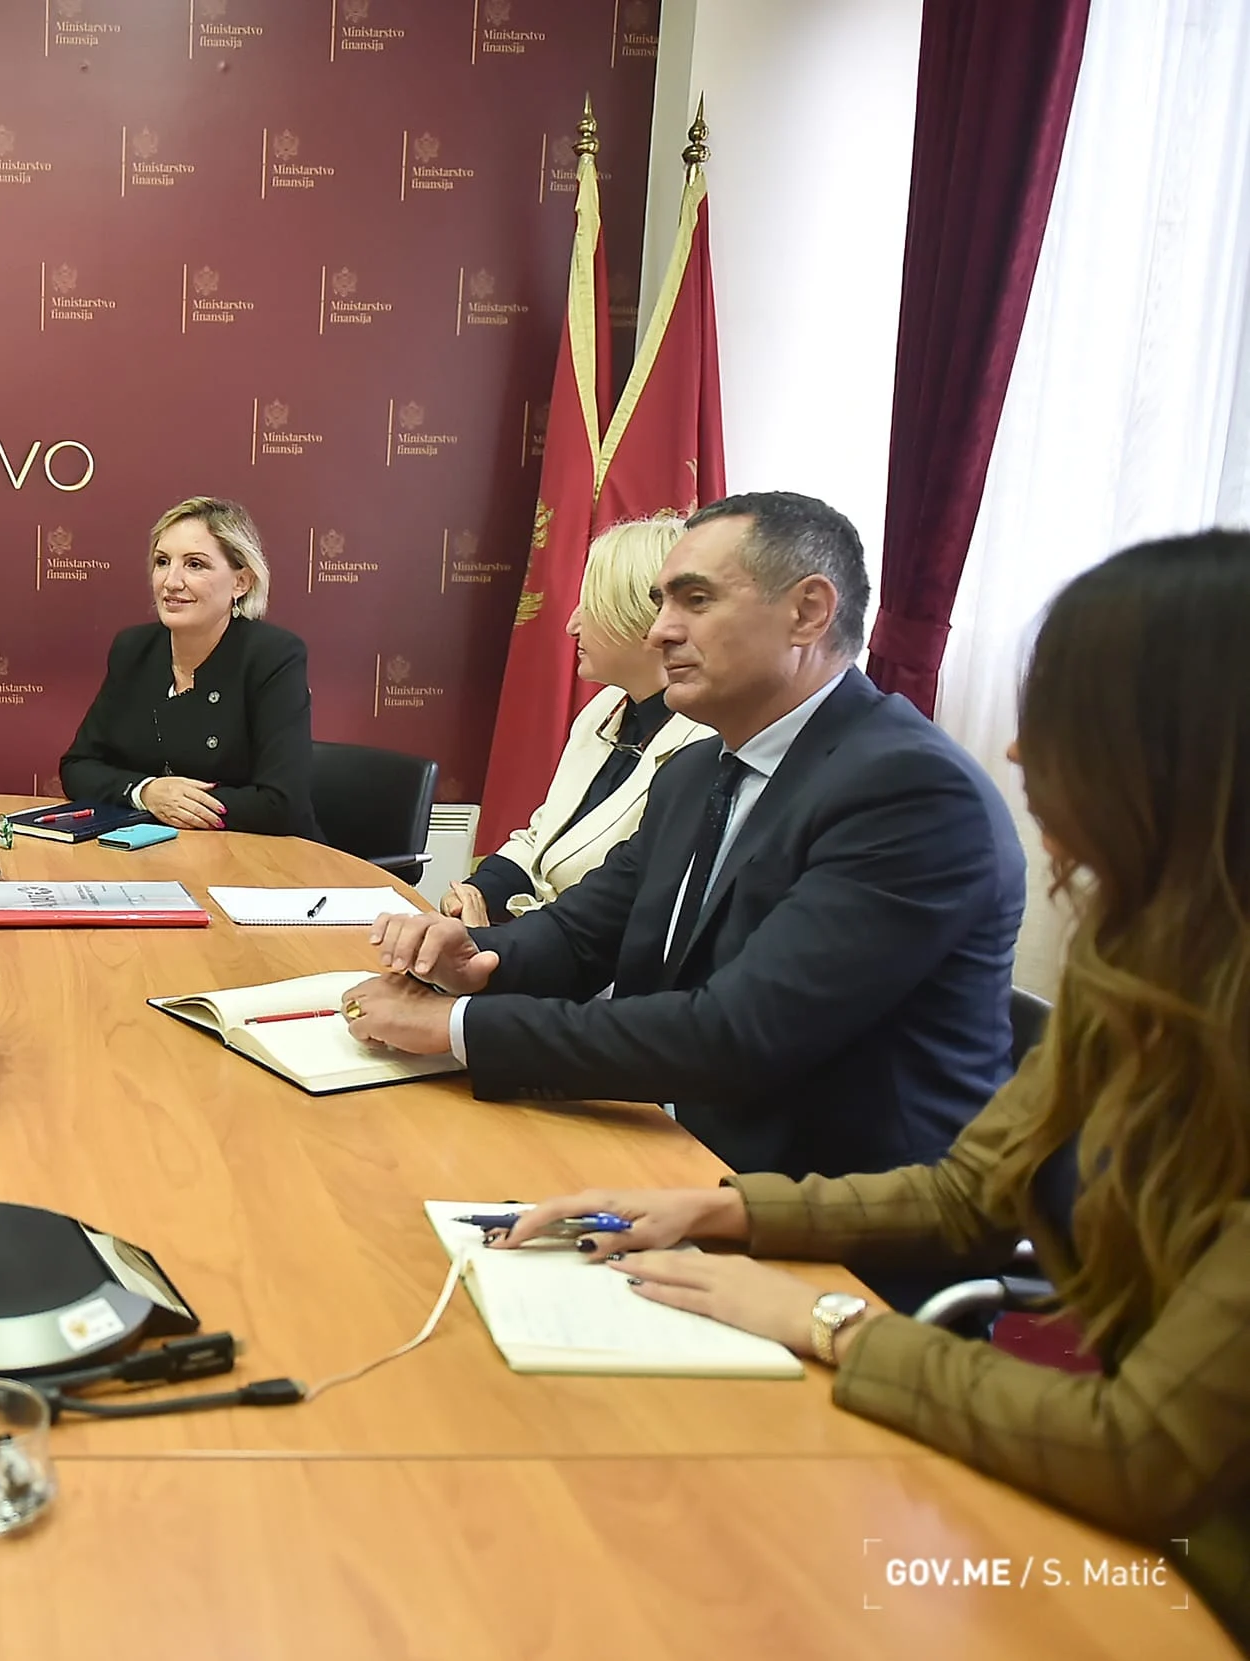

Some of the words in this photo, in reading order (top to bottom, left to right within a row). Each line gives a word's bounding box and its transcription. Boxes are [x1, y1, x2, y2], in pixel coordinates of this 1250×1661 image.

[56, 21, 121, 33] Ministarstvo
[200, 24, 263, 36] Ministarstvo
[342, 27, 405, 39] Ministarstvo
[55, 33, 99, 45] finansija
[199, 36, 243, 48] finansija
[483, 30, 546, 42] Ministarstvo
[341, 39, 384, 51] finansija
[482, 42, 525, 54] finansija
[132, 162, 195, 174] Ministarstvo
[273, 164, 335, 176] Ministarstvo
[412, 166, 474, 178] Ministarstvo
[131, 174, 175, 186] finansija
[272, 176, 315, 188] finansija
[411, 178, 454, 190] finansija
[52, 296, 116, 308] Ministarstvo
[193, 299, 254, 311] Ministarstvo
[331, 300, 392, 312] Ministarstvo
[468, 302, 529, 314] Ministarstvo
[51, 308, 93, 320] finansija
[192, 311, 234, 323] finansija
[330, 312, 372, 324] finansija
[467, 314, 509, 326] finansija
[263, 432, 323, 444] Ministarstvo
[398, 433, 458, 445] Ministarstvo
[262, 444, 303, 455] finansija
[396, 445, 438, 456] finansija
[47, 559, 110, 571] Ministarstvo
[319, 560, 378, 572] Ministarstvo
[452, 561, 511, 573] Ministarstvo
[46, 571, 88, 582] finansija
[318, 572, 359, 583] finansija
[451, 573, 492, 584] finansija
[385, 685, 444, 697] Ministarstvo
[384, 697, 424, 708] finansija
